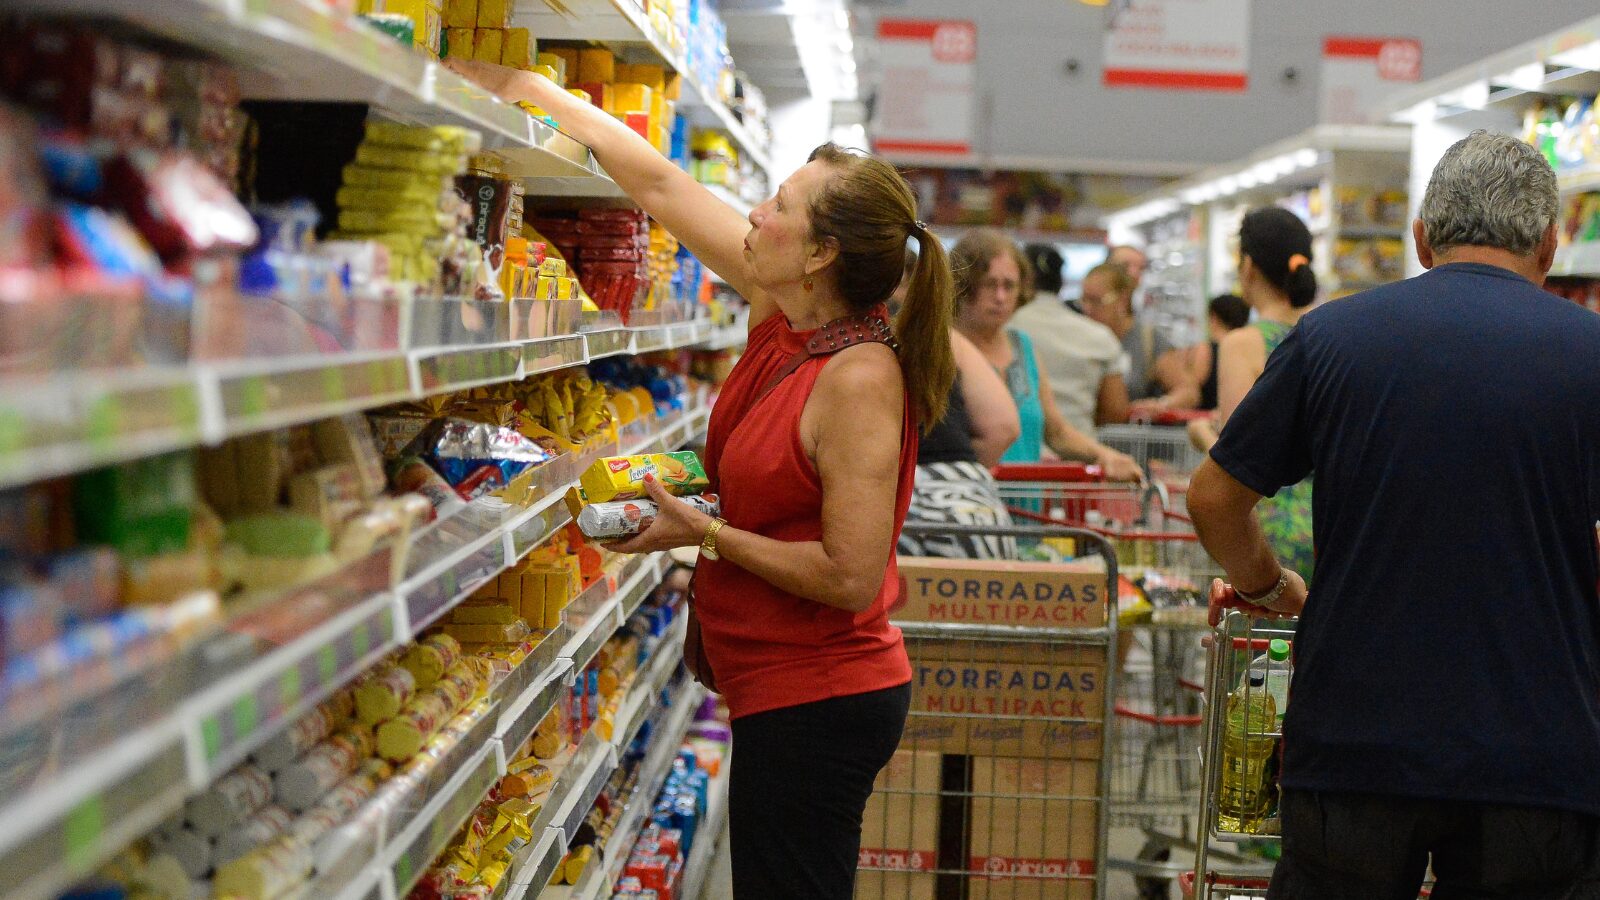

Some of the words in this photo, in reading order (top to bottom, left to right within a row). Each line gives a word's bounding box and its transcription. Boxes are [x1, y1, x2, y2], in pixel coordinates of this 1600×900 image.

[916, 577, 1098, 603] TORRADAS
[928, 603, 1088, 623] MULTIPACK
[918, 667, 1096, 693] TORRADAS
[926, 694, 1085, 717] MULTIPACK
